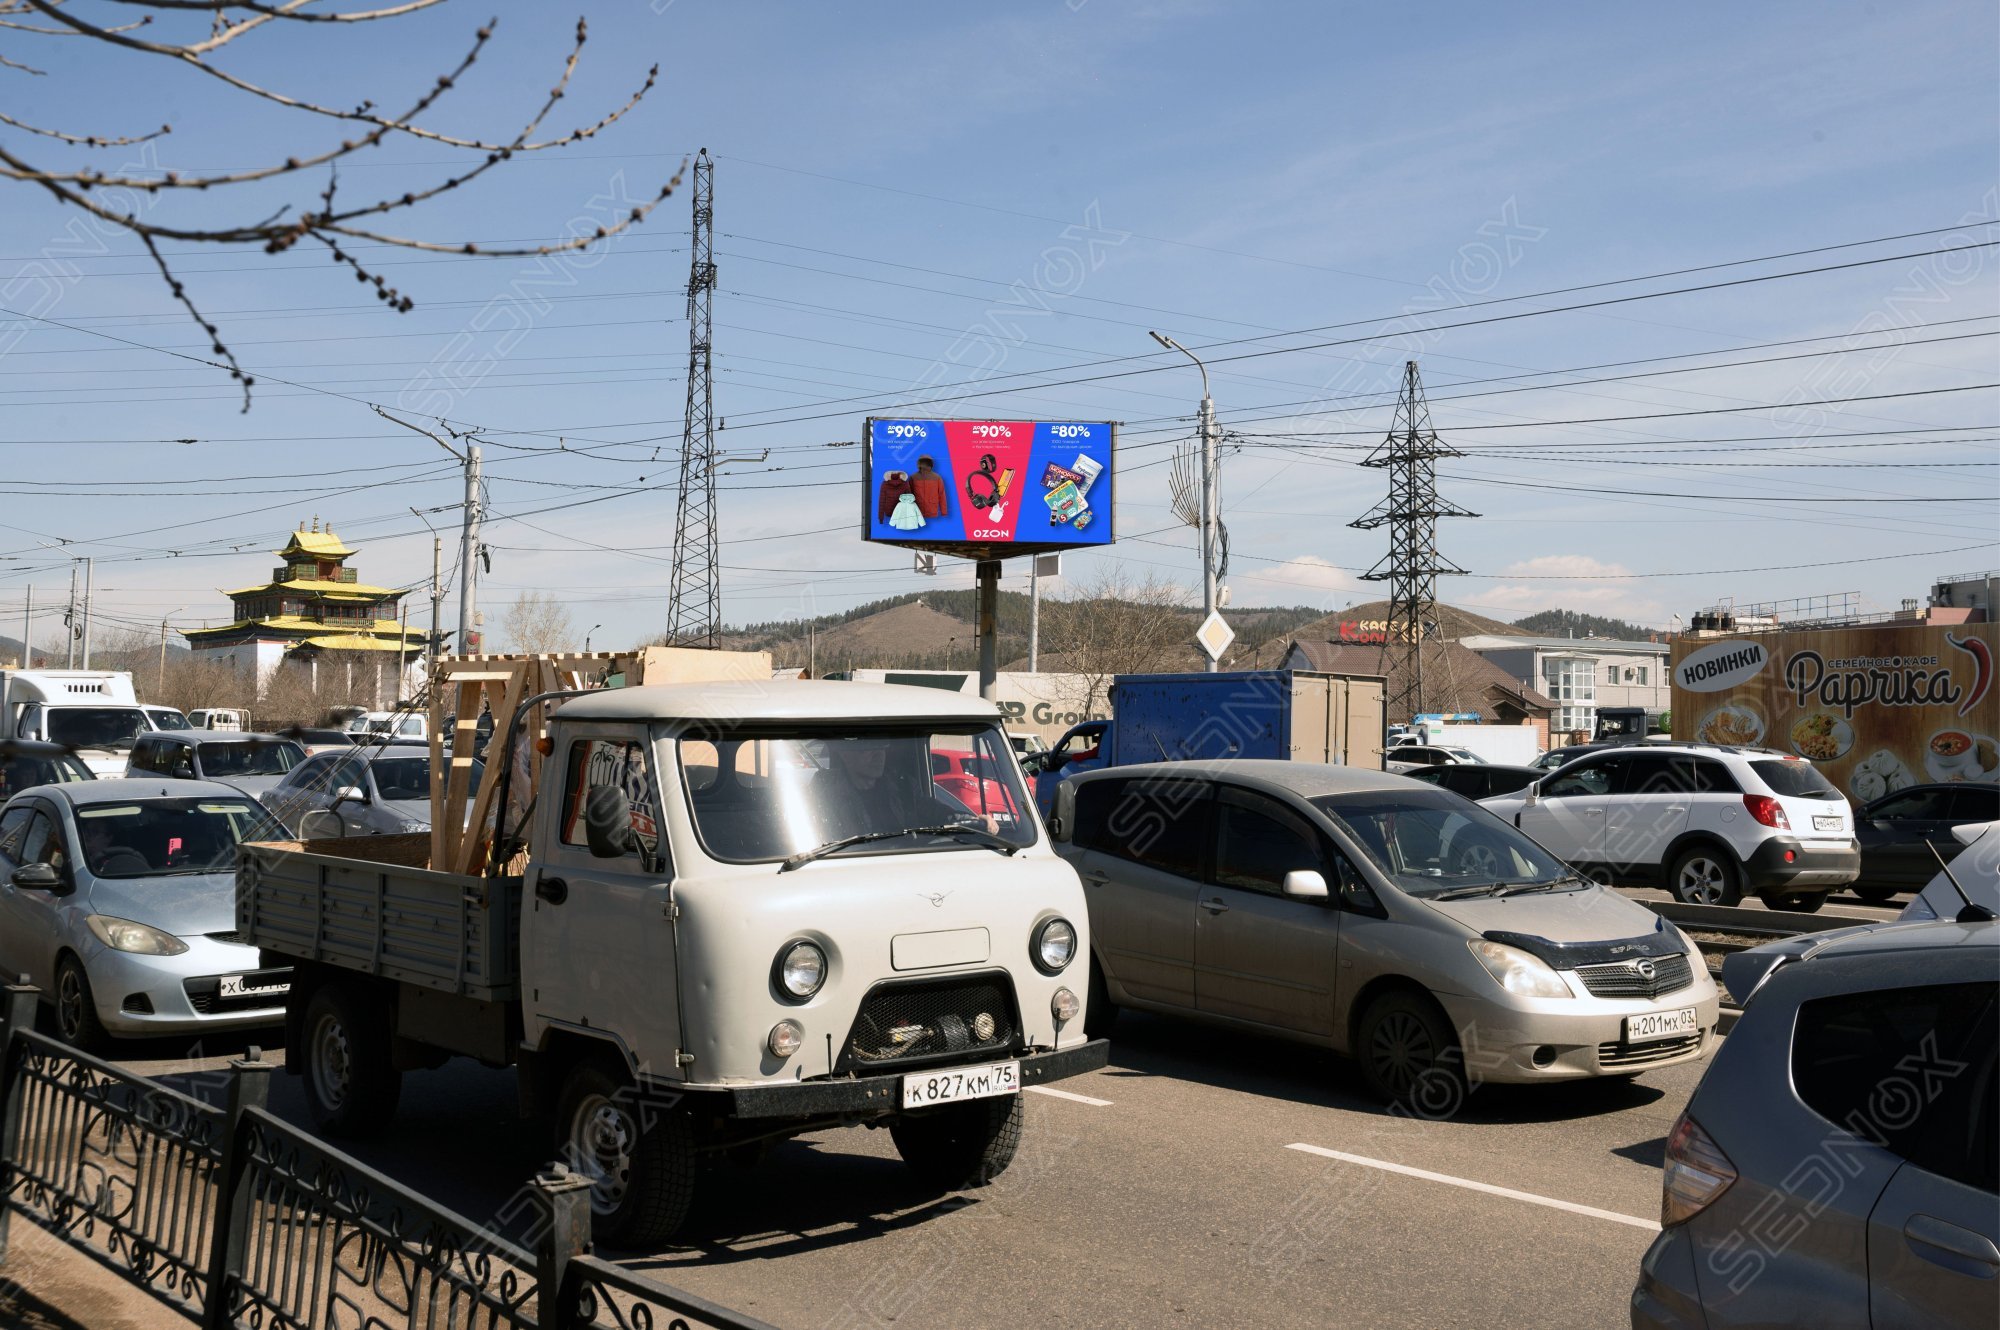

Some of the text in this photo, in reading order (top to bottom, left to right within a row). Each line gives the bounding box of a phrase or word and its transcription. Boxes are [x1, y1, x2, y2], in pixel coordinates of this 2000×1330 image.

[974, 530, 1008, 538] OZON
[1683, 646, 1761, 685] НОВИНКИ
[1828, 656, 1937, 668] СЕМЕЙНОЕ КАФЕ
[1681, 1010, 1692, 1024] 03
[995, 1066, 1012, 1084] 75
